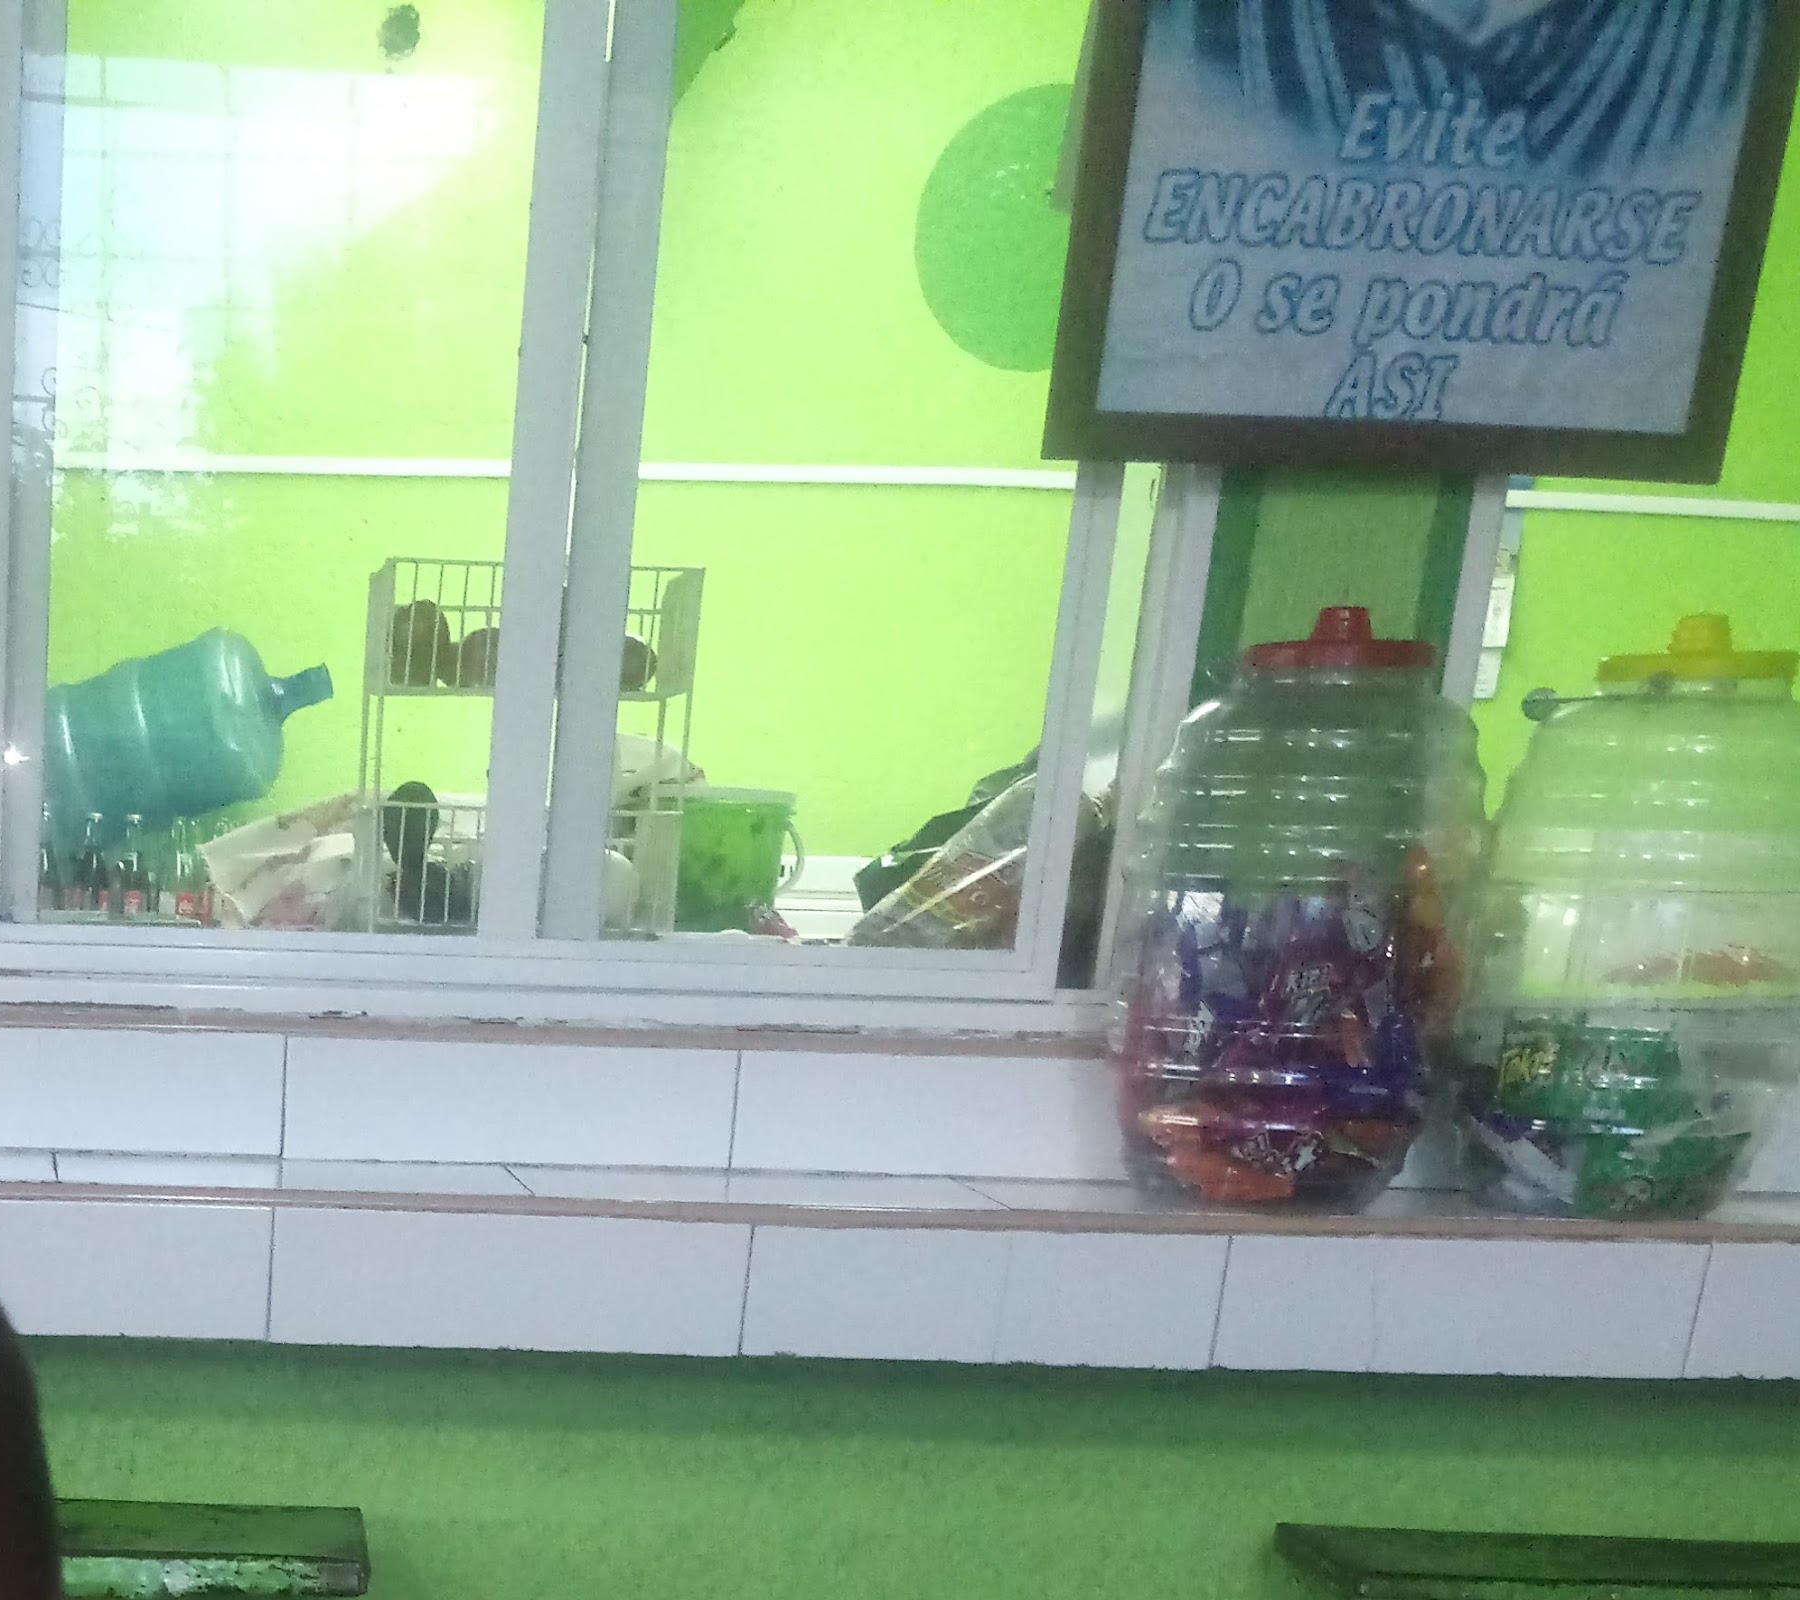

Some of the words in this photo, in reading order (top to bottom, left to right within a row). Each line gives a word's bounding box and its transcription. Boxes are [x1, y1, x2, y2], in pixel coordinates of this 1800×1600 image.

[1339, 92, 1528, 169] Evite
[1143, 168, 1703, 265] ENCABRONARSE
[1187, 258, 1243, 332] O
[1257, 272, 1341, 335] se
[1352, 269, 1630, 347] pondrá
[1324, 351, 1461, 420] ASI
